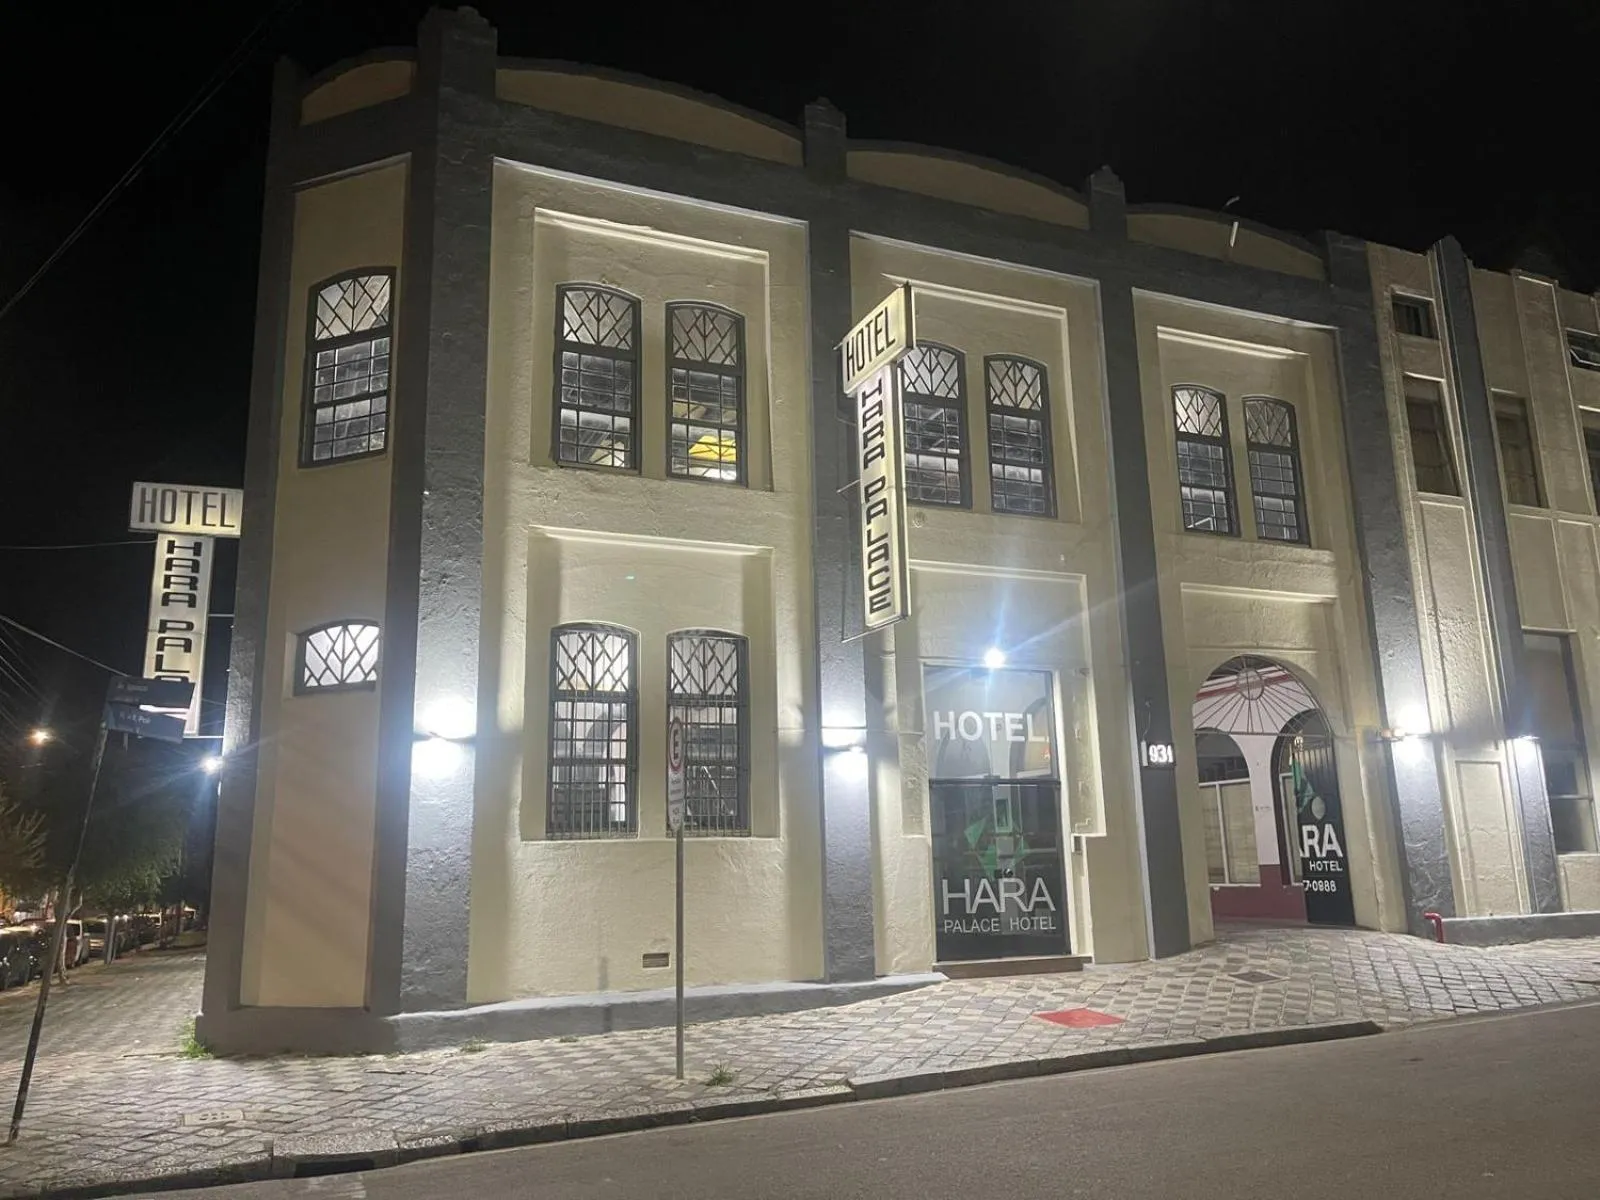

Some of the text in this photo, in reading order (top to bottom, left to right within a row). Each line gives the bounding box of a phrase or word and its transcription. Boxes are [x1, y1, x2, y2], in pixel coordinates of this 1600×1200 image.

[846, 306, 896, 381] HOTEL
[139, 487, 235, 528] HOTEL
[861, 378, 892, 614] HARA PALACE
[161, 540, 202, 608] HARA
[933, 710, 1049, 742] HOTEL
[1149, 744, 1173, 763] 931
[1299, 823, 1343, 857] RA
[1309, 860, 1343, 872] HOTEL
[942, 877, 1056, 915] HARA
[944, 915, 1056, 934] PALACE HOTEL
